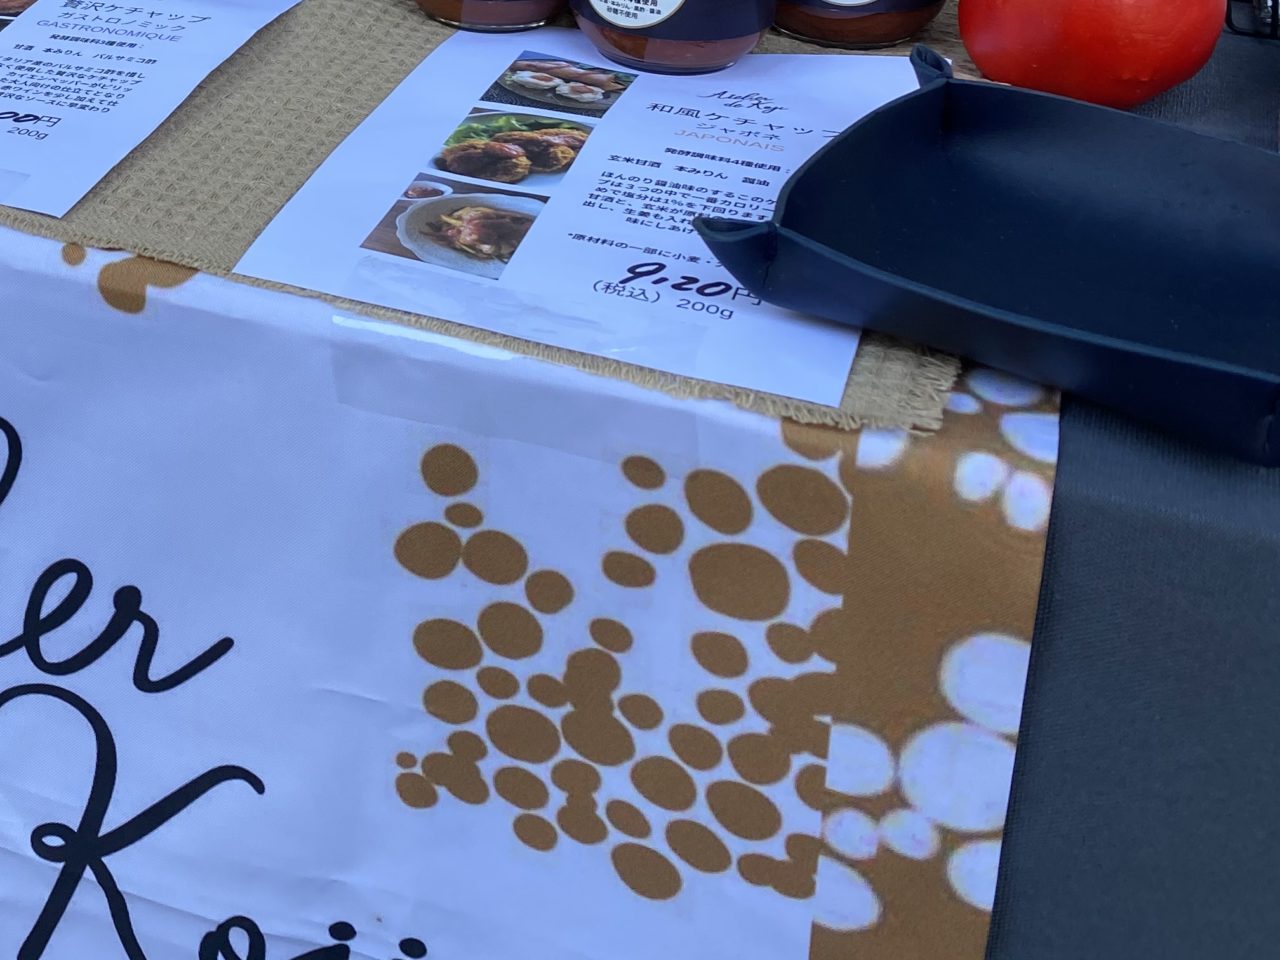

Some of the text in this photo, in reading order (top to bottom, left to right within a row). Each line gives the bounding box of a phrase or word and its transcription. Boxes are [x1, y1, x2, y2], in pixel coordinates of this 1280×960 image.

[36, 20, 183, 42] GASTRONOMIQUE
[58, 11, 186, 31] ガストロノミック
[7, 126, 49, 140] 200g
[674, 129, 785, 152] JAPONAIS
[696, 123, 782, 141] ジャポネ
[608, 155, 662, 169] 玄米甘酒
[674, 165, 728, 180] 本みりん
[676, 298, 734, 320] 200g
